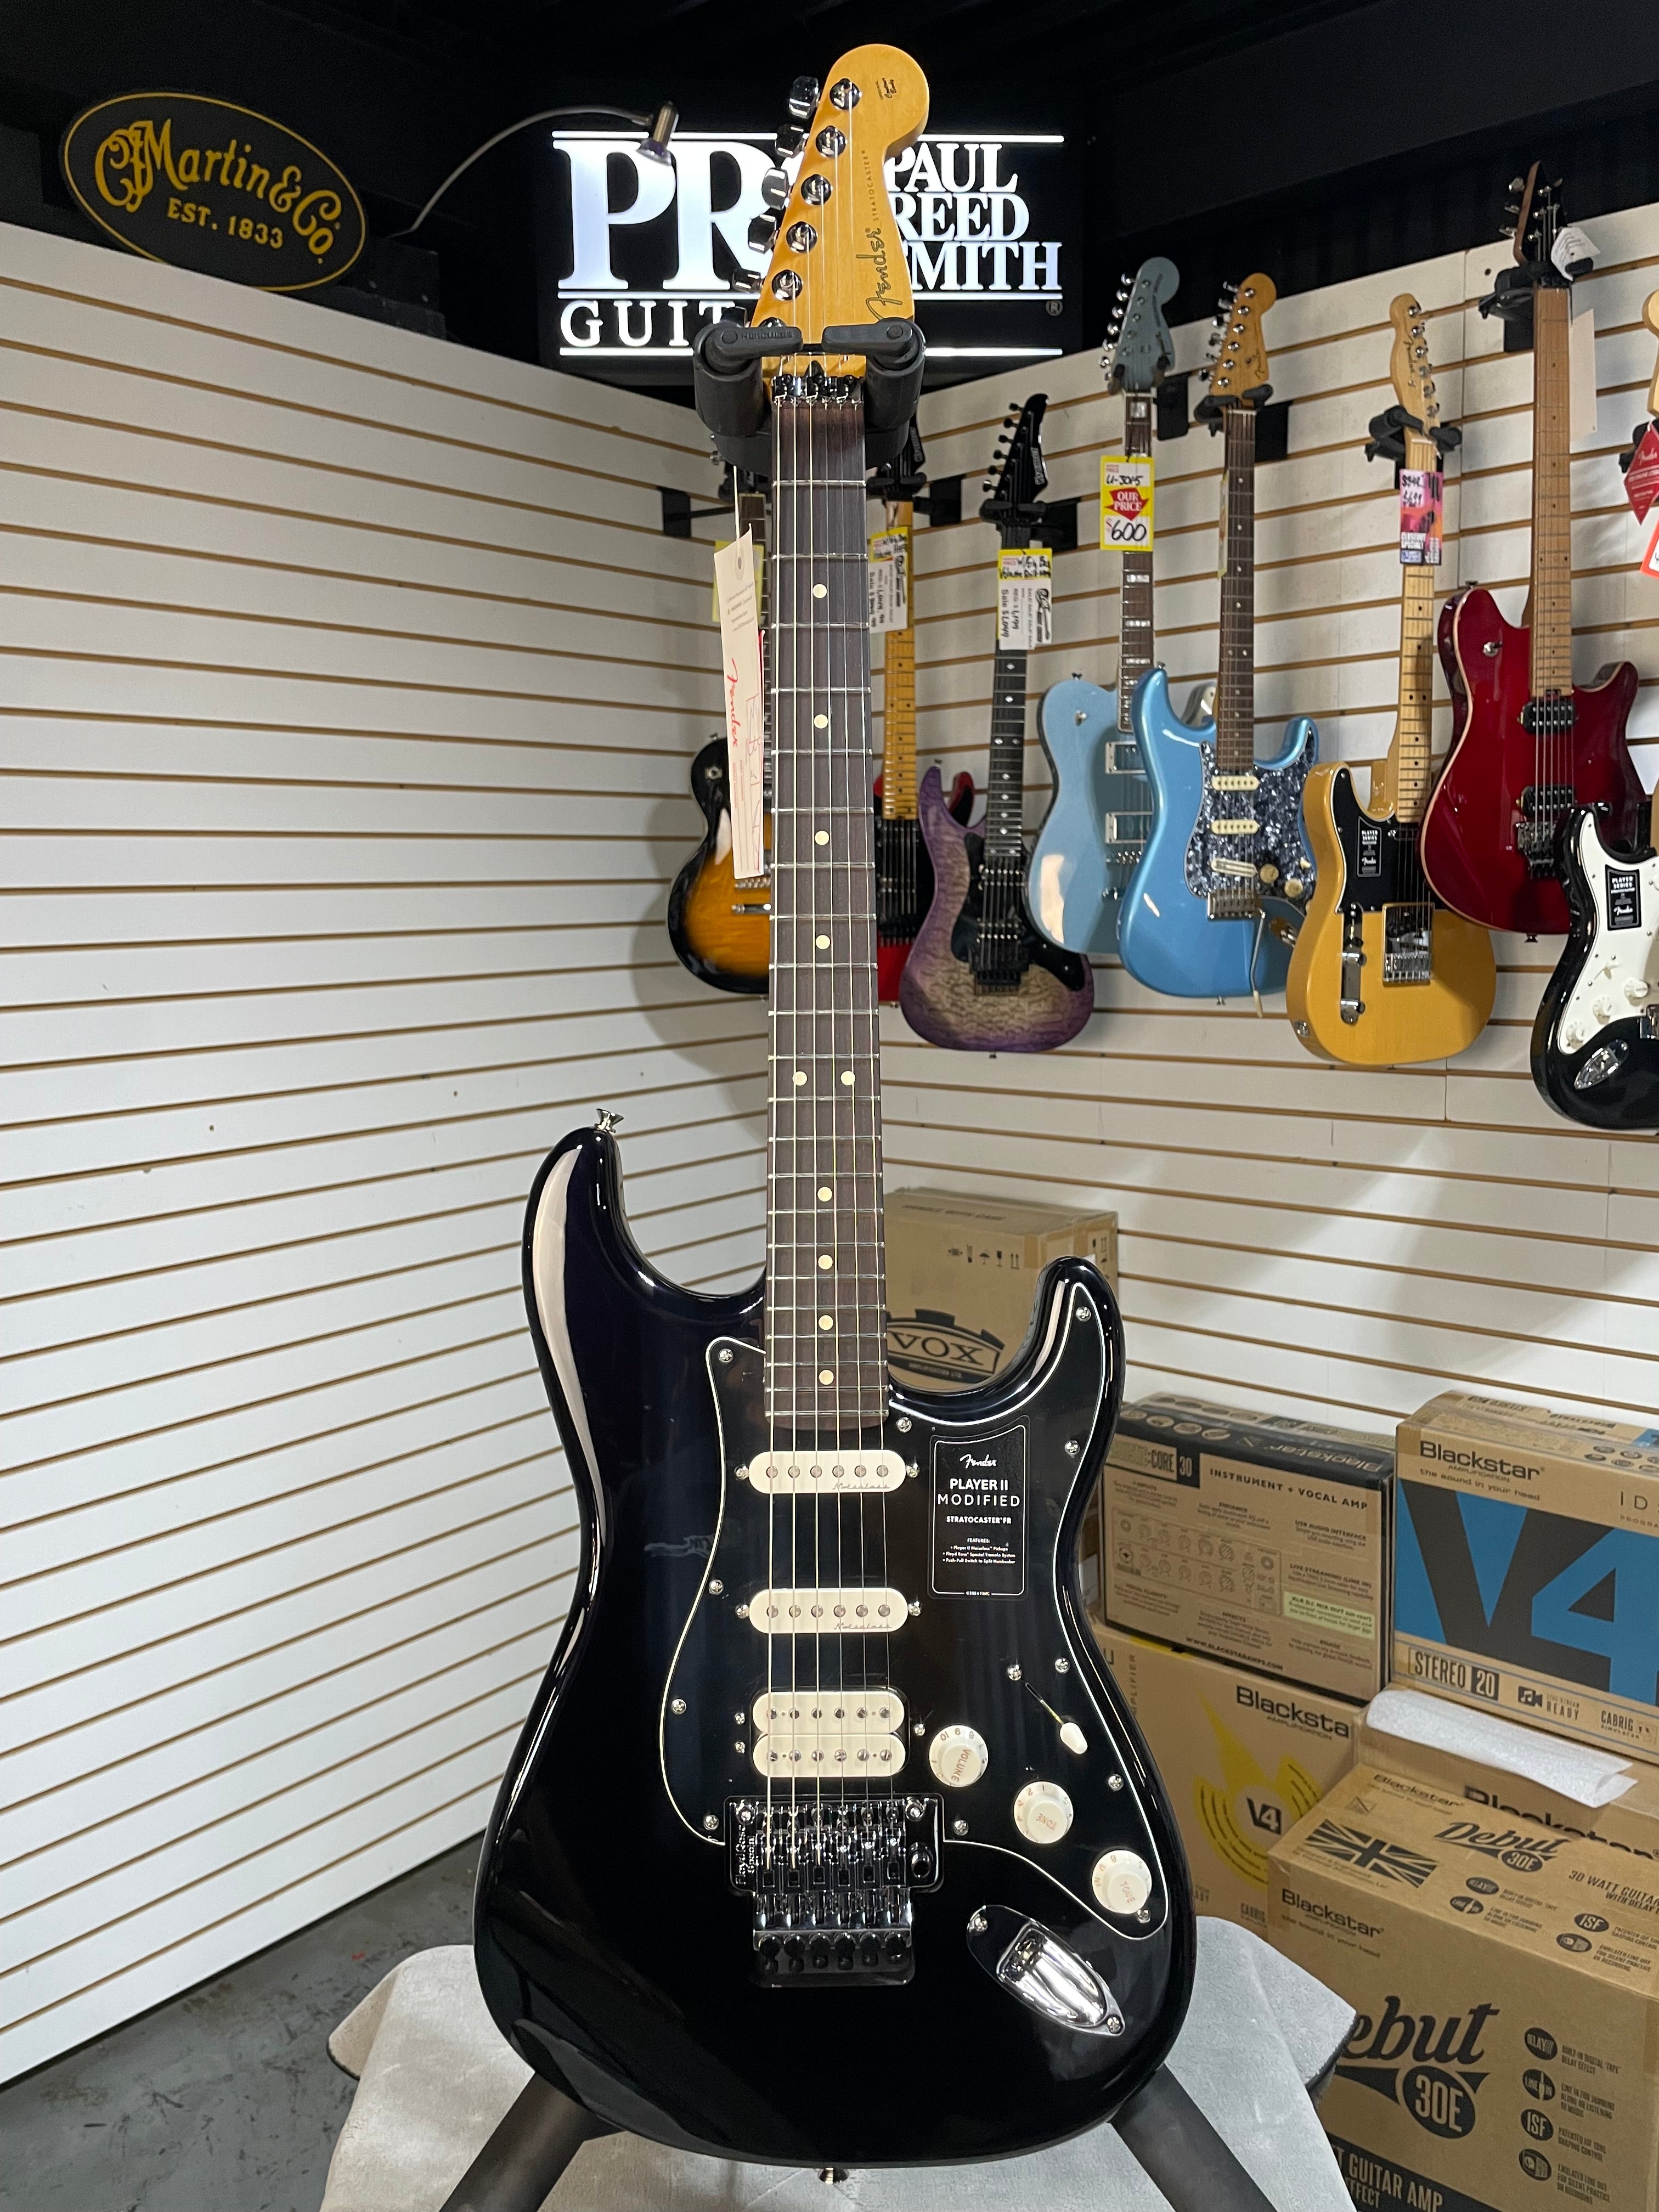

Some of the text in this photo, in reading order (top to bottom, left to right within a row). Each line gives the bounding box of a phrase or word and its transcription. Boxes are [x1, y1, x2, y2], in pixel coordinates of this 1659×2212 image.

[884, 143, 1018, 193] PAUL
[167, 198, 284, 249] EST. 1833
[552, 139, 802, 291] PR
[888, 192, 1030, 241] REED
[908, 241, 1063, 291] MITH
[560, 300, 736, 348] GUIT
[1114, 501, 1142, 512] PRICE
[1116, 491, 1139, 501] OUR
[725, 658, 740, 748] Fender
[888, 1330, 984, 1367] VOX
[960, 1454, 997, 1469] Fender
[1179, 1455, 1193, 1477] 30
[1419, 1440, 1541, 1480] Blackstar
[937, 1493, 1020, 1507] MODIFIED
[950, 1478, 1008, 1491] PLAYER II
[1210, 1468, 1284, 1492] INSTRUMENT
[1298, 1487, 1338, 1504] VOCAL
[1341, 1496, 1368, 1510] AMP
[1620, 1513, 1659, 1529] PROGRA
[1414, 1651, 1496, 1698] STEREO 20
[1237, 1685, 1349, 1739] Blacksta
[1546, 1701, 1580, 1721] READY
[951, 1749, 972, 1782] VOLUME
[1373, 1773, 1462, 1808] Blackstar
[1035, 1812, 1058, 1831] TONE
[1246, 1796, 1282, 1836] V4
[1434, 1821, 1571, 1854] Debut
[1506, 1851, 1538, 1872] 30E
[1120, 1880, 1136, 1904] TONE
[1568, 1870, 1585, 1882] 30
[1587, 1875, 1620, 1893] WATT
[1282, 1888, 1381, 1938] Blackstar
[1605, 1891, 1655, 1912] WITH DELAY
[1579, 1915, 1604, 1930] ISF
[1339, 1995, 1500, 2065] ebut
[1415, 2074, 1463, 2133] 30E
[1527, 2111, 1547, 2137] ISF
[1344, 2176, 1381, 2209] FFECT
[1348, 2153, 1403, 2200] GUITAR
[1407, 2181, 1444, 2212] AMP
